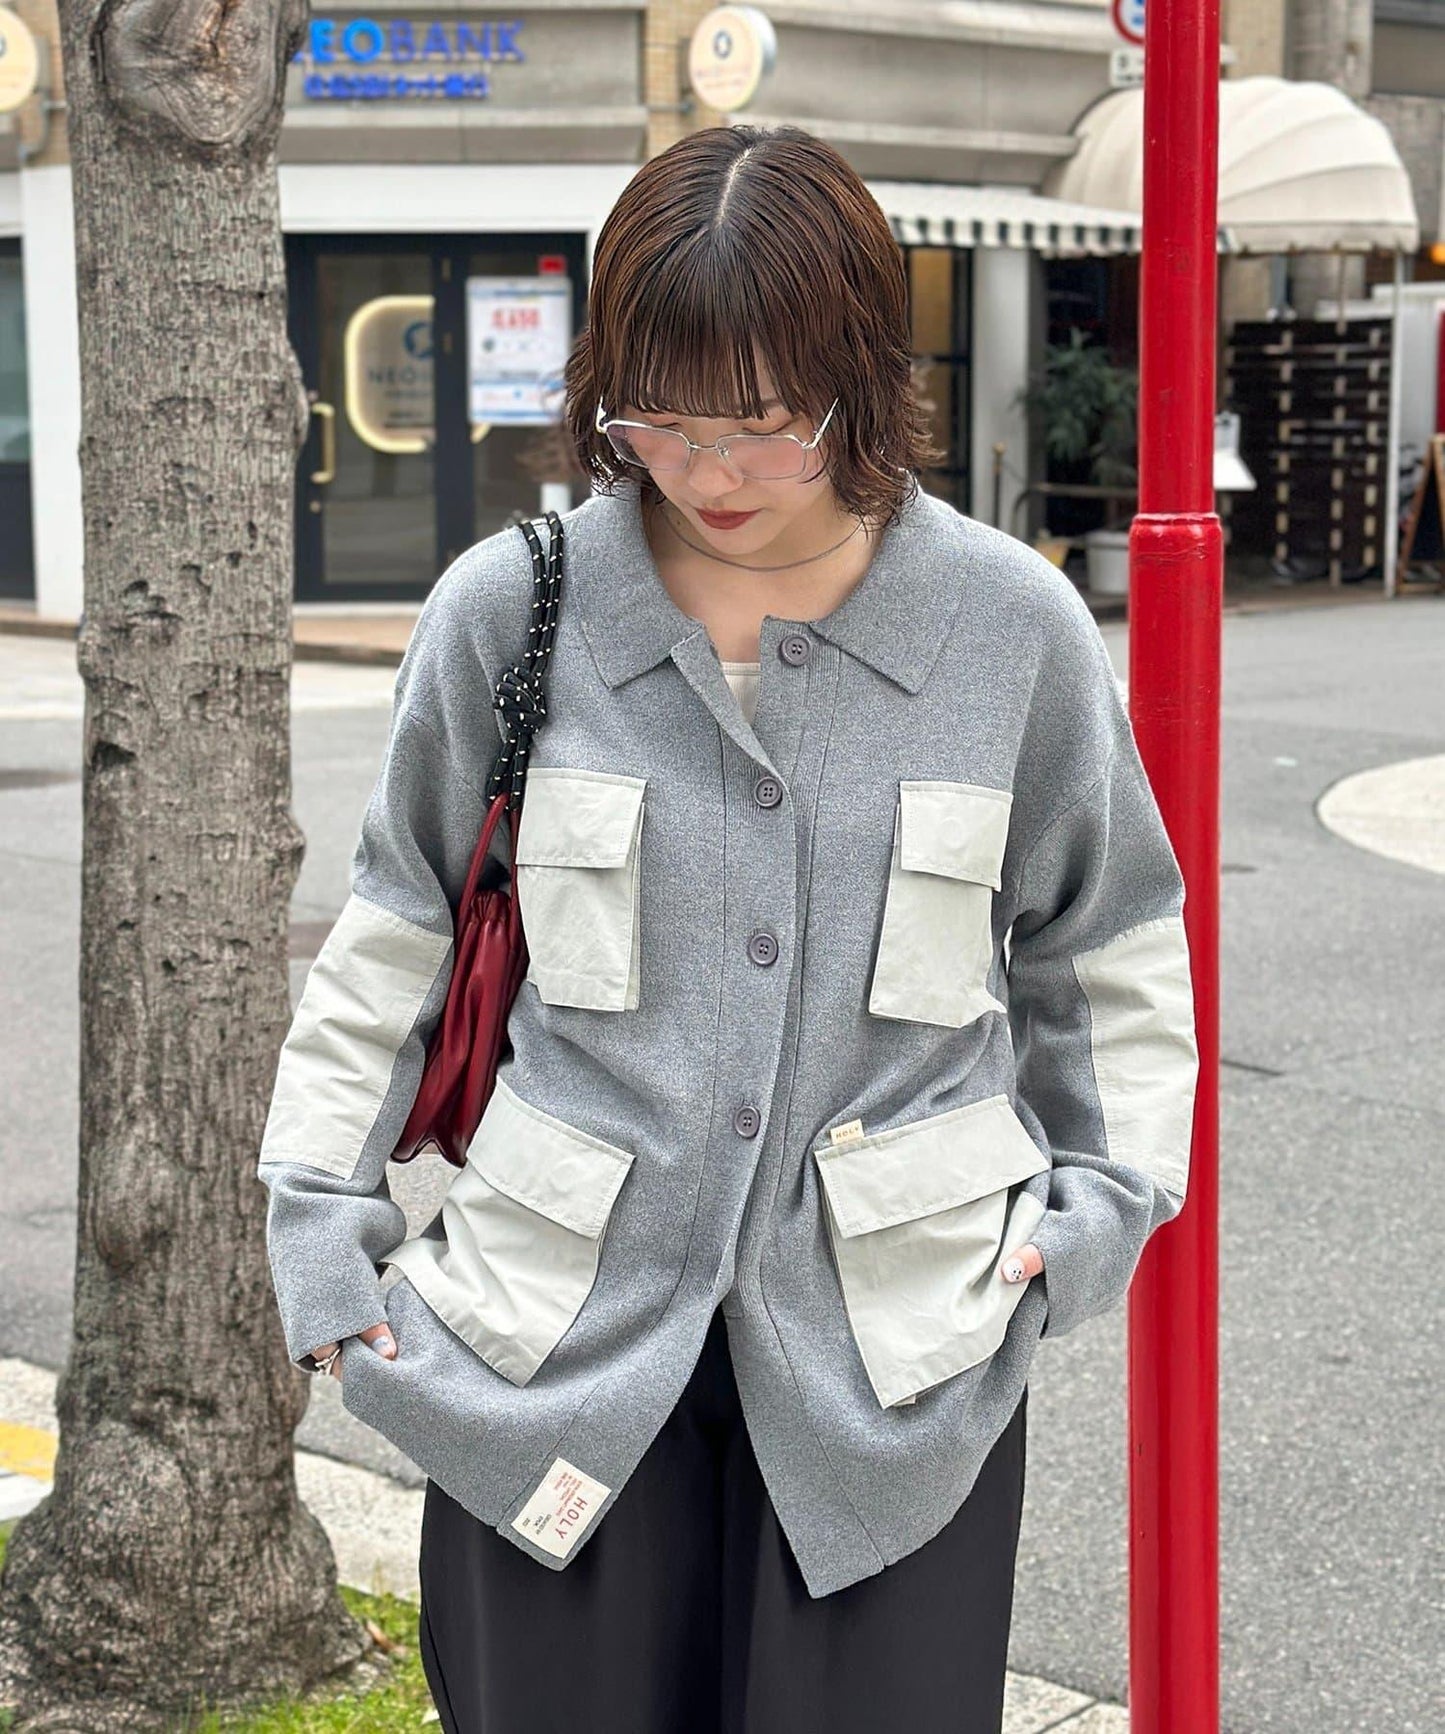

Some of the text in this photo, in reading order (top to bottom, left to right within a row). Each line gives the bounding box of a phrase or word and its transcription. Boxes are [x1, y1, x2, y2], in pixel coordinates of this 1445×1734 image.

[292, 17, 525, 63] EOBANK
[835, 1125, 859, 1139] HOLY
[555, 1496, 588, 1540] HOLY
